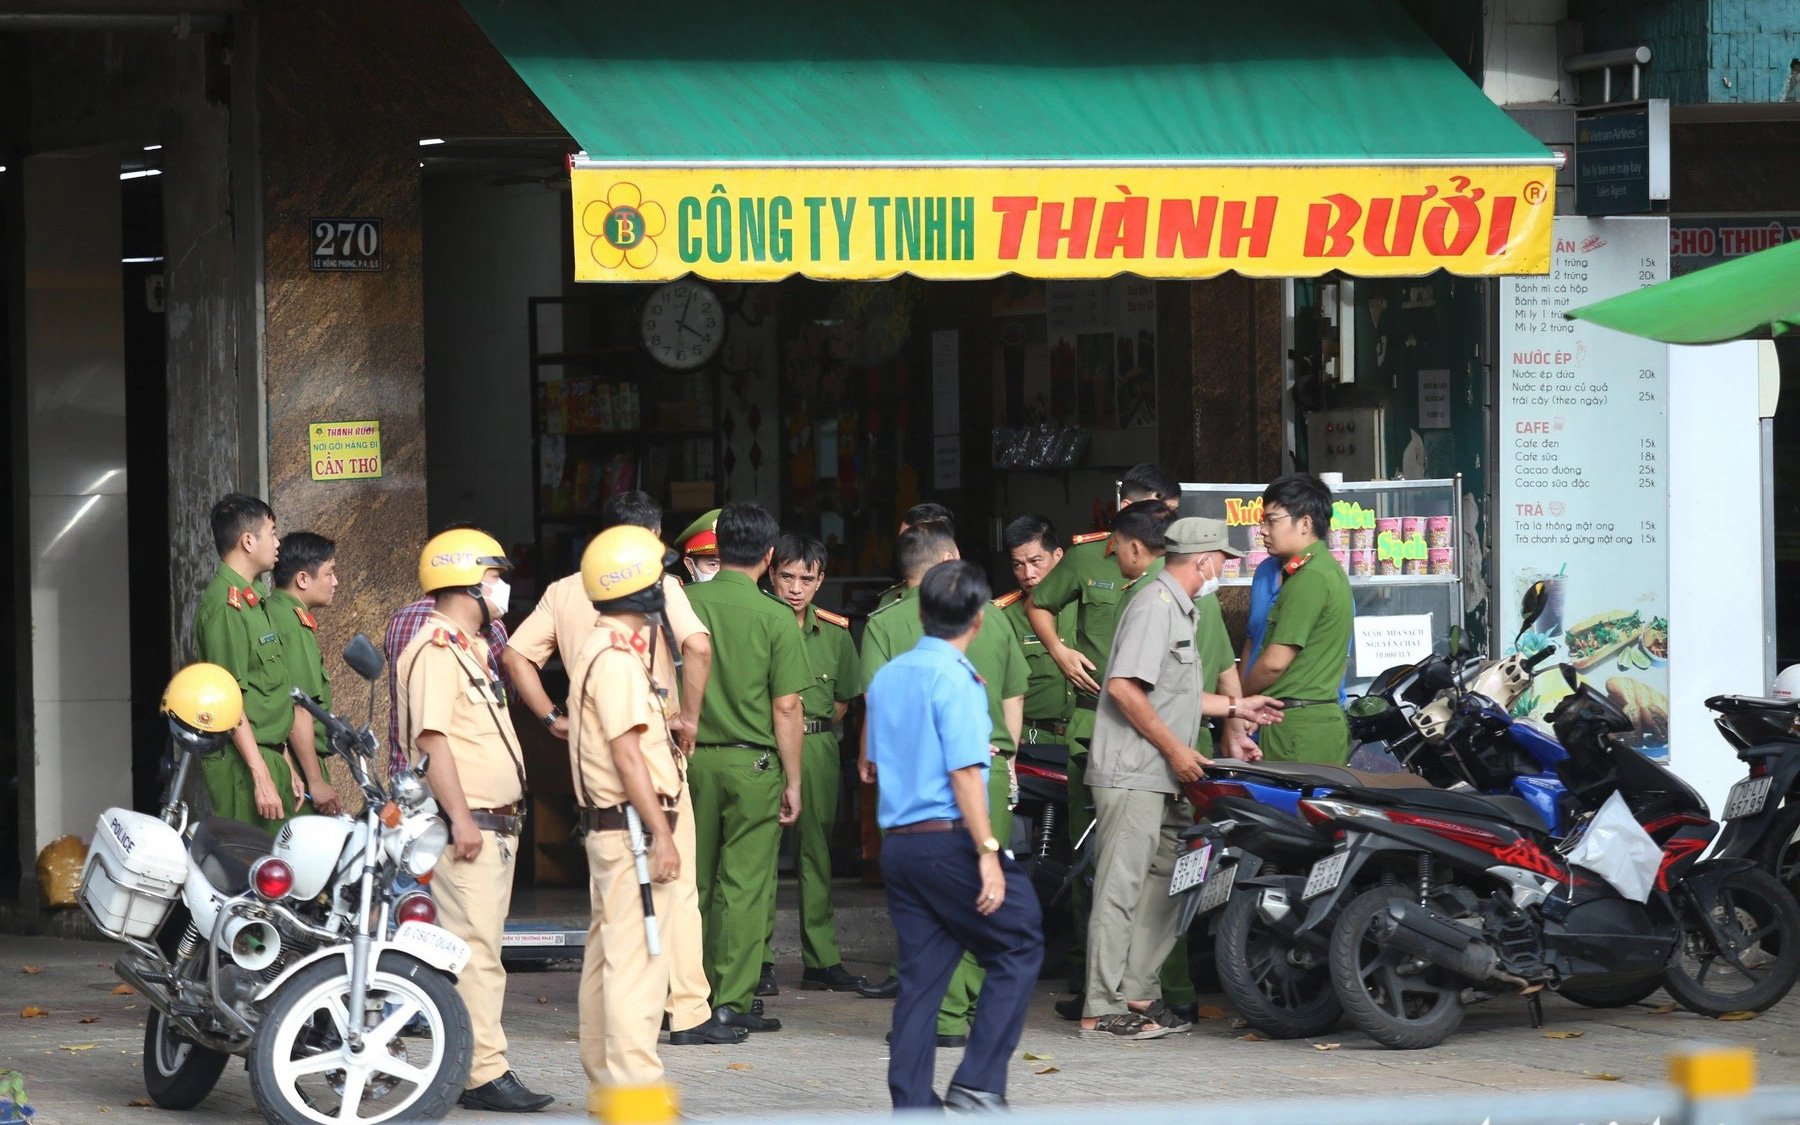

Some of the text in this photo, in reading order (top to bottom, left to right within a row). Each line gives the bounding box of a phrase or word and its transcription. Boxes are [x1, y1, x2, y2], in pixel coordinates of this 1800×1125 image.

[678, 184, 793, 264] CÔNG
[804, 197, 857, 262] TY
[868, 197, 974, 261] TNHH
[992, 185, 1279, 259] THÀNH
[1303, 175, 1518, 258] BƯỞI
[316, 222, 378, 256] 270
[1719, 221, 1784, 256] THUÊ
[1556, 238, 1575, 252] ĂN
[1564, 258, 1588, 268] trứng
[1641, 258, 1656, 267] 15k
[1554, 270, 1560, 280] 2
[1564, 272, 1588, 280] trứng
[1639, 270, 1656, 280] 20k
[1515, 283, 1538, 292] Bánh
[1554, 284, 1566, 292] cá
[1570, 284, 1588, 294] hộp
[1515, 296, 1538, 306] Bánh
[1554, 298, 1570, 306] mứt
[1530, 310, 1537, 320] ly
[1530, 322, 1537, 333] ly
[1540, 322, 1546, 332] 2
[1550, 324, 1574, 333] trứng
[1513, 349, 1572, 364] NƯỚC ÉP
[1512, 370, 1575, 380] Nước ép dứa
[1639, 370, 1656, 379] 20k
[1512, 382, 1536, 392] Nước
[1540, 384, 1552, 392] ép
[1574, 382, 1586, 392] củ
[1590, 382, 1608, 393] quả
[1512, 395, 1608, 406] trái cây (theo ngày)
[1638, 392, 1656, 402] 25k
[1516, 422, 1550, 434] CAFE
[1515, 438, 1559, 448] Cafe đen
[1640, 438, 1656, 448] 15k
[1515, 452, 1558, 461] Cafe sữa
[1640, 452, 1656, 461] 18k
[316, 452, 378, 476] CẦN THƠ
[1515, 465, 1548, 474] Cacao
[1639, 465, 1656, 474] 25k
[1515, 478, 1590, 488] Cacao sữa đặc
[1639, 478, 1656, 488] 25k
[1225, 497, 1376, 531] Nướ Siêu
[1516, 502, 1544, 516] TRÀ
[1515, 521, 1614, 531] Trà lá thông mật ong
[1640, 521, 1656, 530] 15k
[1515, 534, 1528, 544] Trà
[1531, 534, 1557, 544] chanh
[1598, 535, 1613, 544] mật
[1616, 536, 1632, 544] ong
[1641, 534, 1656, 544] 15k
[1378, 530, 1428, 568] Sạch
[431, 552, 474, 568] CSGT
[600, 563, 642, 587] CSGT
[110, 818, 136, 854] POLICE
